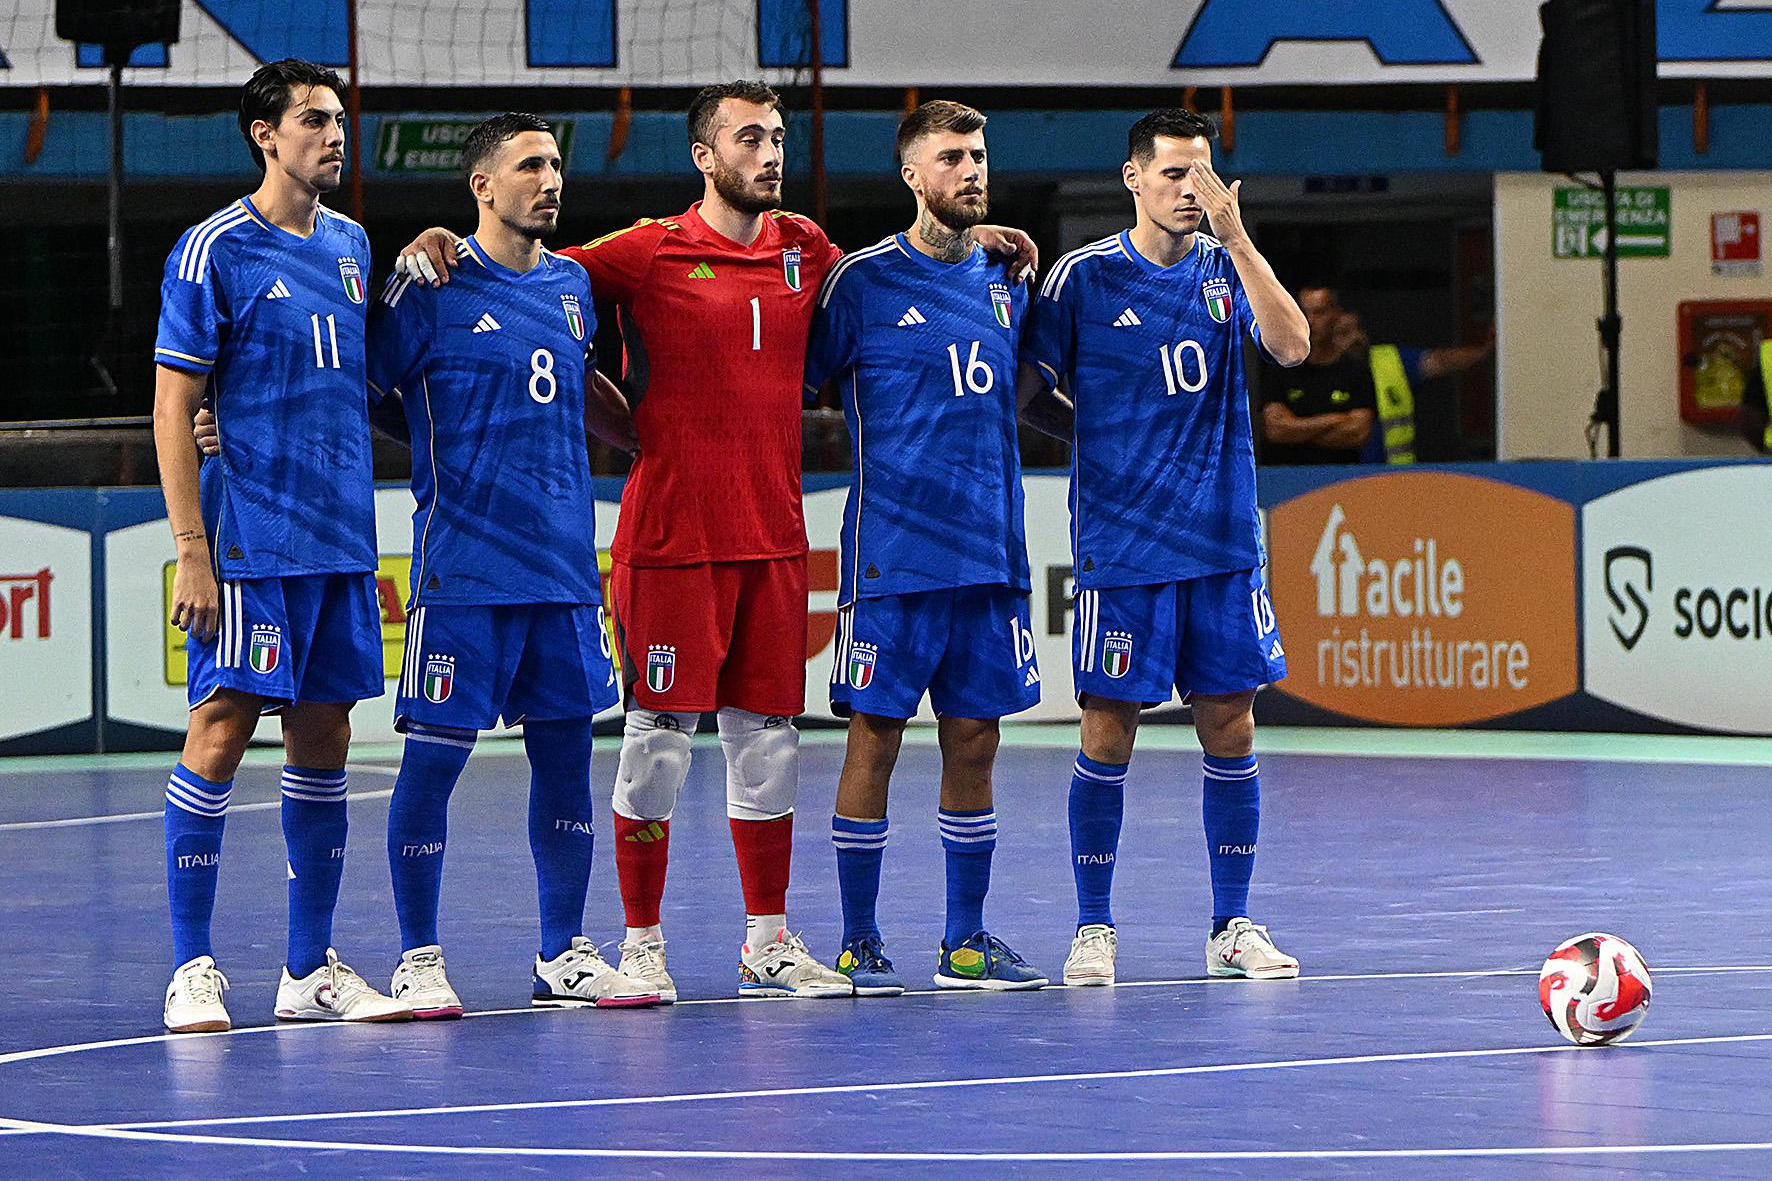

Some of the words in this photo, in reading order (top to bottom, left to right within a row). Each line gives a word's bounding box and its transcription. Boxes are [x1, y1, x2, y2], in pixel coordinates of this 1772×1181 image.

[1205, 286, 1232, 298] ITALIA
[749, 296, 761, 350] 1
[311, 313, 341, 369] 11
[946, 340, 994, 397] 16
[1159, 339, 1209, 396] 10
[528, 348, 557, 404] 8
[254, 633, 278, 645] ITALIA
[597, 605, 612, 660] 8
[1106, 639, 1130, 651] ITALIA
[650, 655, 673, 664] ITALIA
[852, 651, 874, 663] ITALIA
[1317, 626, 1530, 690] ristrutturare
[428, 663, 451, 675] ITALIA
[402, 842, 444, 857] ITALIA
[1219, 844, 1257, 856] ITALIA
[177, 853, 219, 869] ITALIA
[1077, 852, 1116, 865] ITALIA
